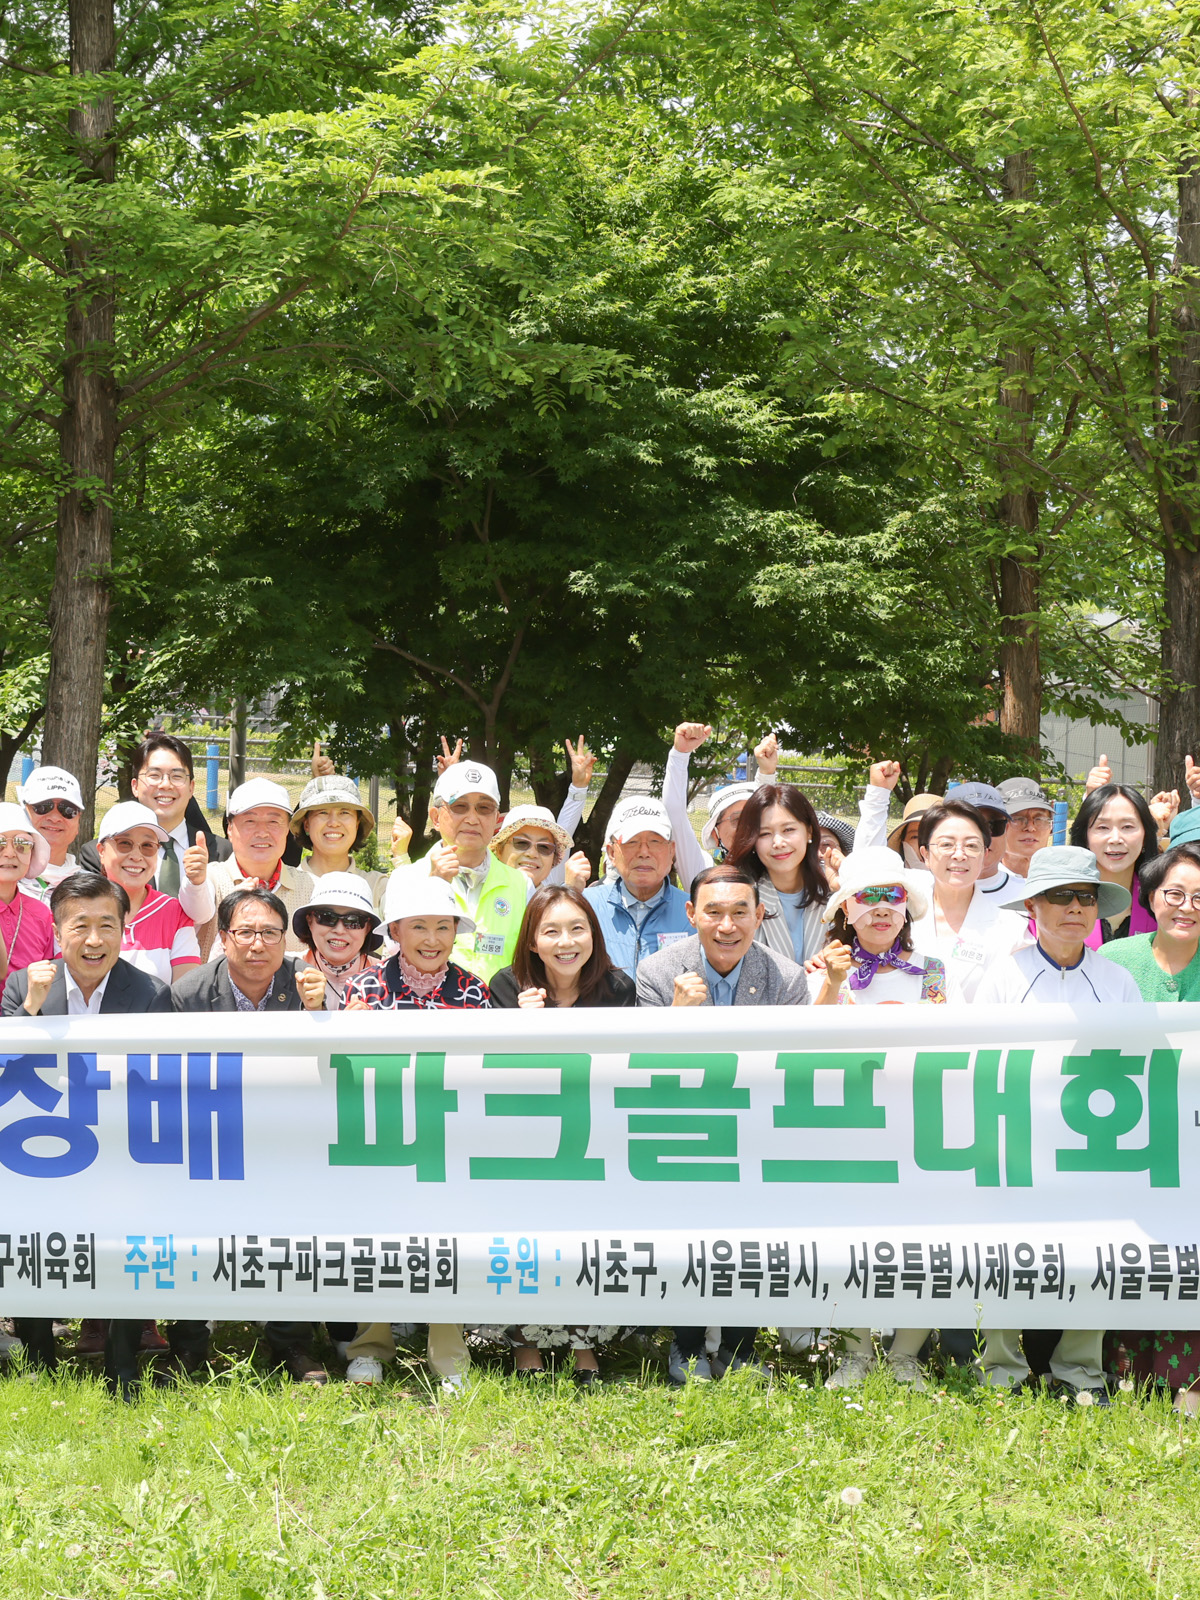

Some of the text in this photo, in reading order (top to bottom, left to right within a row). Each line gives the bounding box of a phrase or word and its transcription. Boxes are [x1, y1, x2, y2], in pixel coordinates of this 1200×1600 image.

[620, 805, 661, 823] Titleist
[329, 1049, 1182, 1187] 파크골프대회
[124, 1234, 177, 1290] 주관
[213, 1235, 457, 1294] 서초구파크골프협회
[487, 1238, 539, 1295] 후원
[576, 1238, 666, 1299] 서초구,
[682, 1240, 828, 1300] 서울특별시,
[844, 1241, 1075, 1302] 서울특별시체육회,
